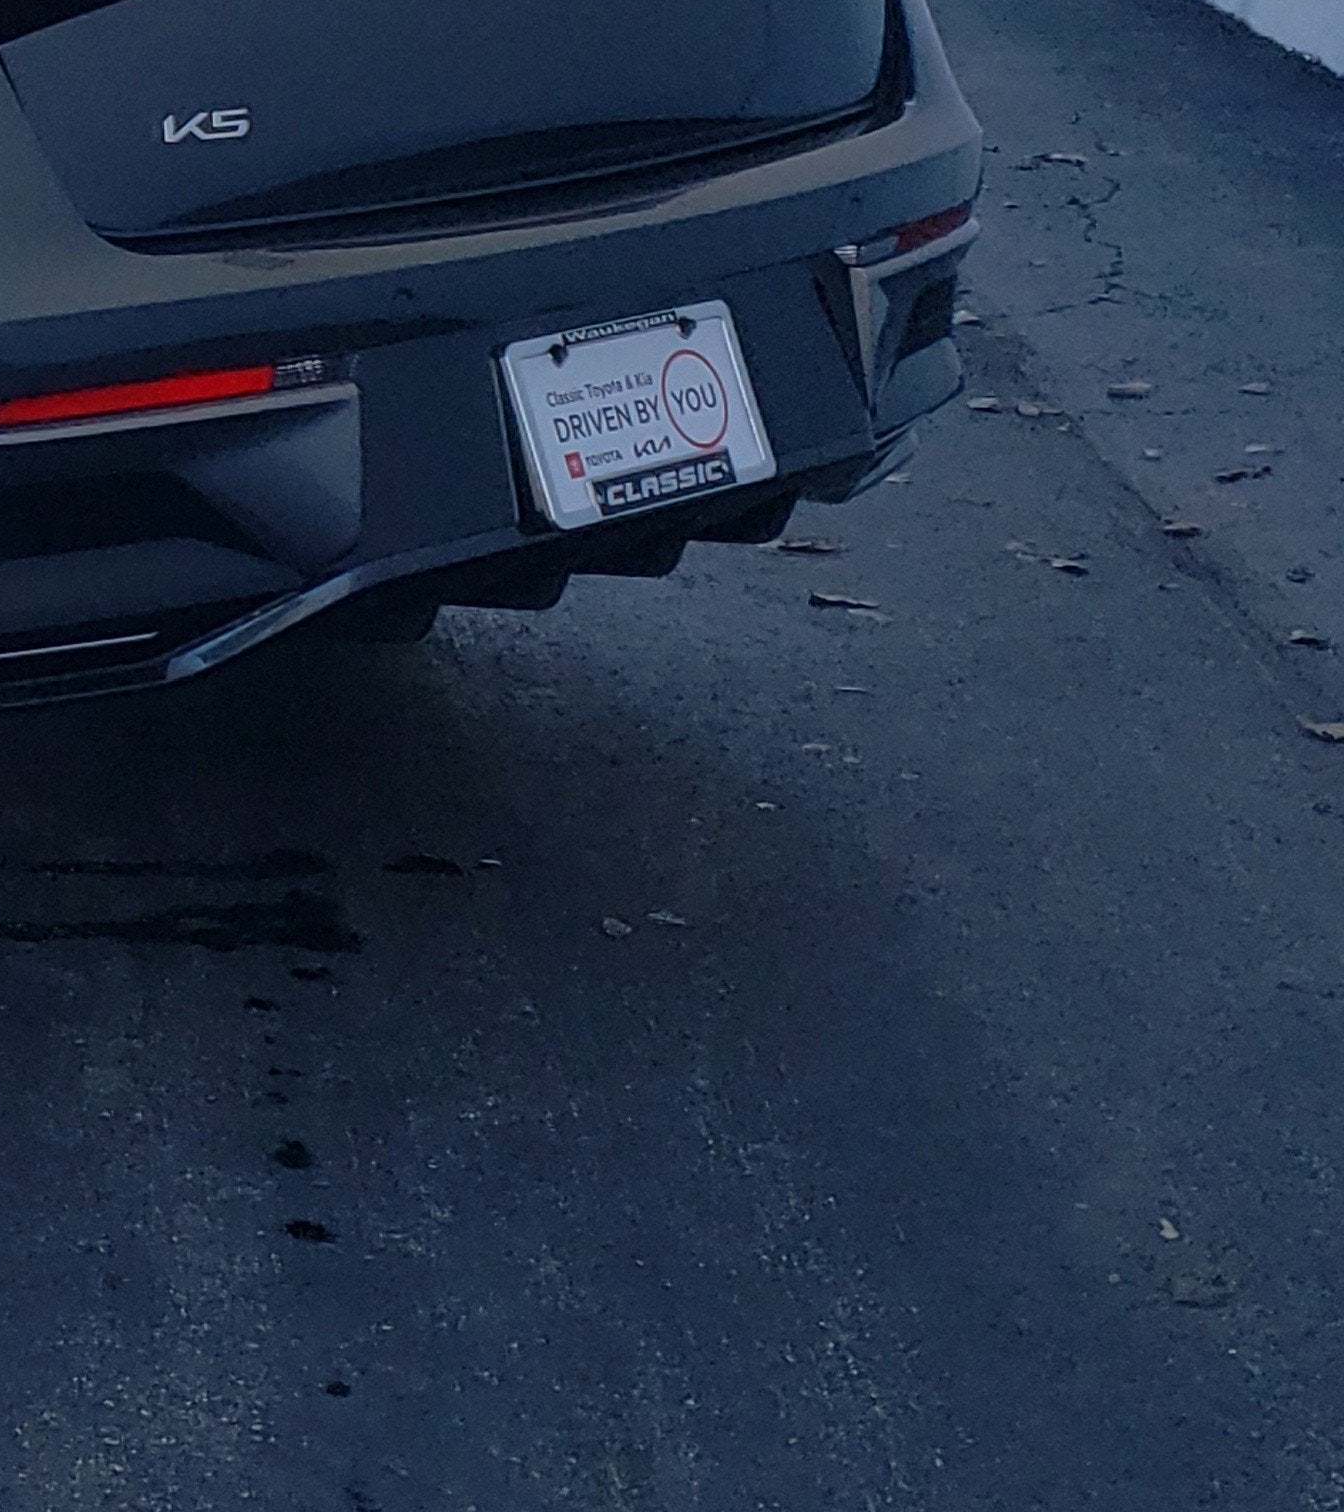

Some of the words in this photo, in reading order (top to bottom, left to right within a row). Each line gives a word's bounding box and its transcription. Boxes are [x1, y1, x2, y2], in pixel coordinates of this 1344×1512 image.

[163, 107, 251, 144] K5
[565, 312, 675, 343] Waukegan
[546, 389, 584, 407] Classic
[583, 379, 624, 400] Toyota
[634, 372, 653, 387] Kia
[553, 402, 634, 443] DRIVEN
[634, 394, 660, 424] BY
[670, 382, 718, 417] YOU
[585, 449, 623, 467] TOYOTA
[633, 435, 672, 458] KIA
[606, 459, 725, 506] CLASSIC
